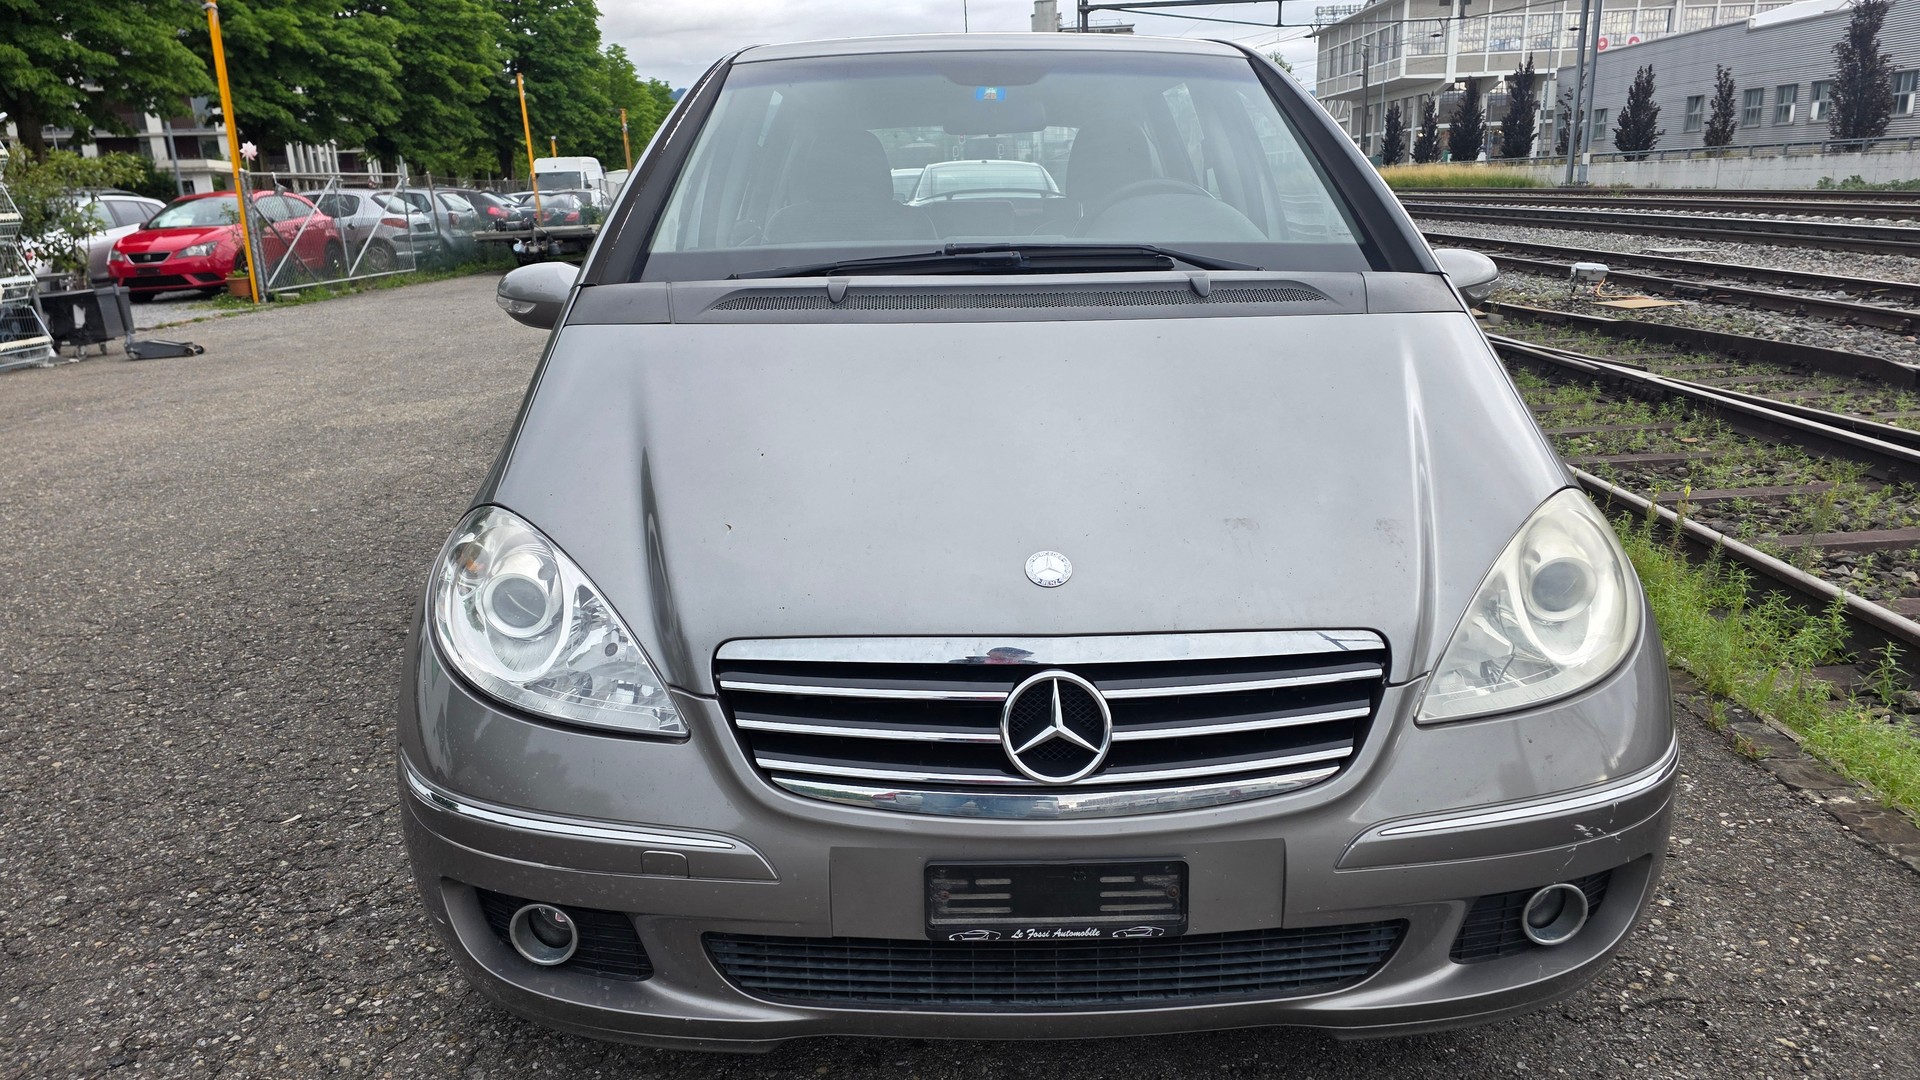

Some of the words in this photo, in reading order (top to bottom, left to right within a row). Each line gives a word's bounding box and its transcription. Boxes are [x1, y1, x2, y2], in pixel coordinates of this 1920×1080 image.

[1011, 929, 1024, 939] Le
[1026, 928, 1051, 940] Fossi
[1052, 927, 1101, 938] Automobile
